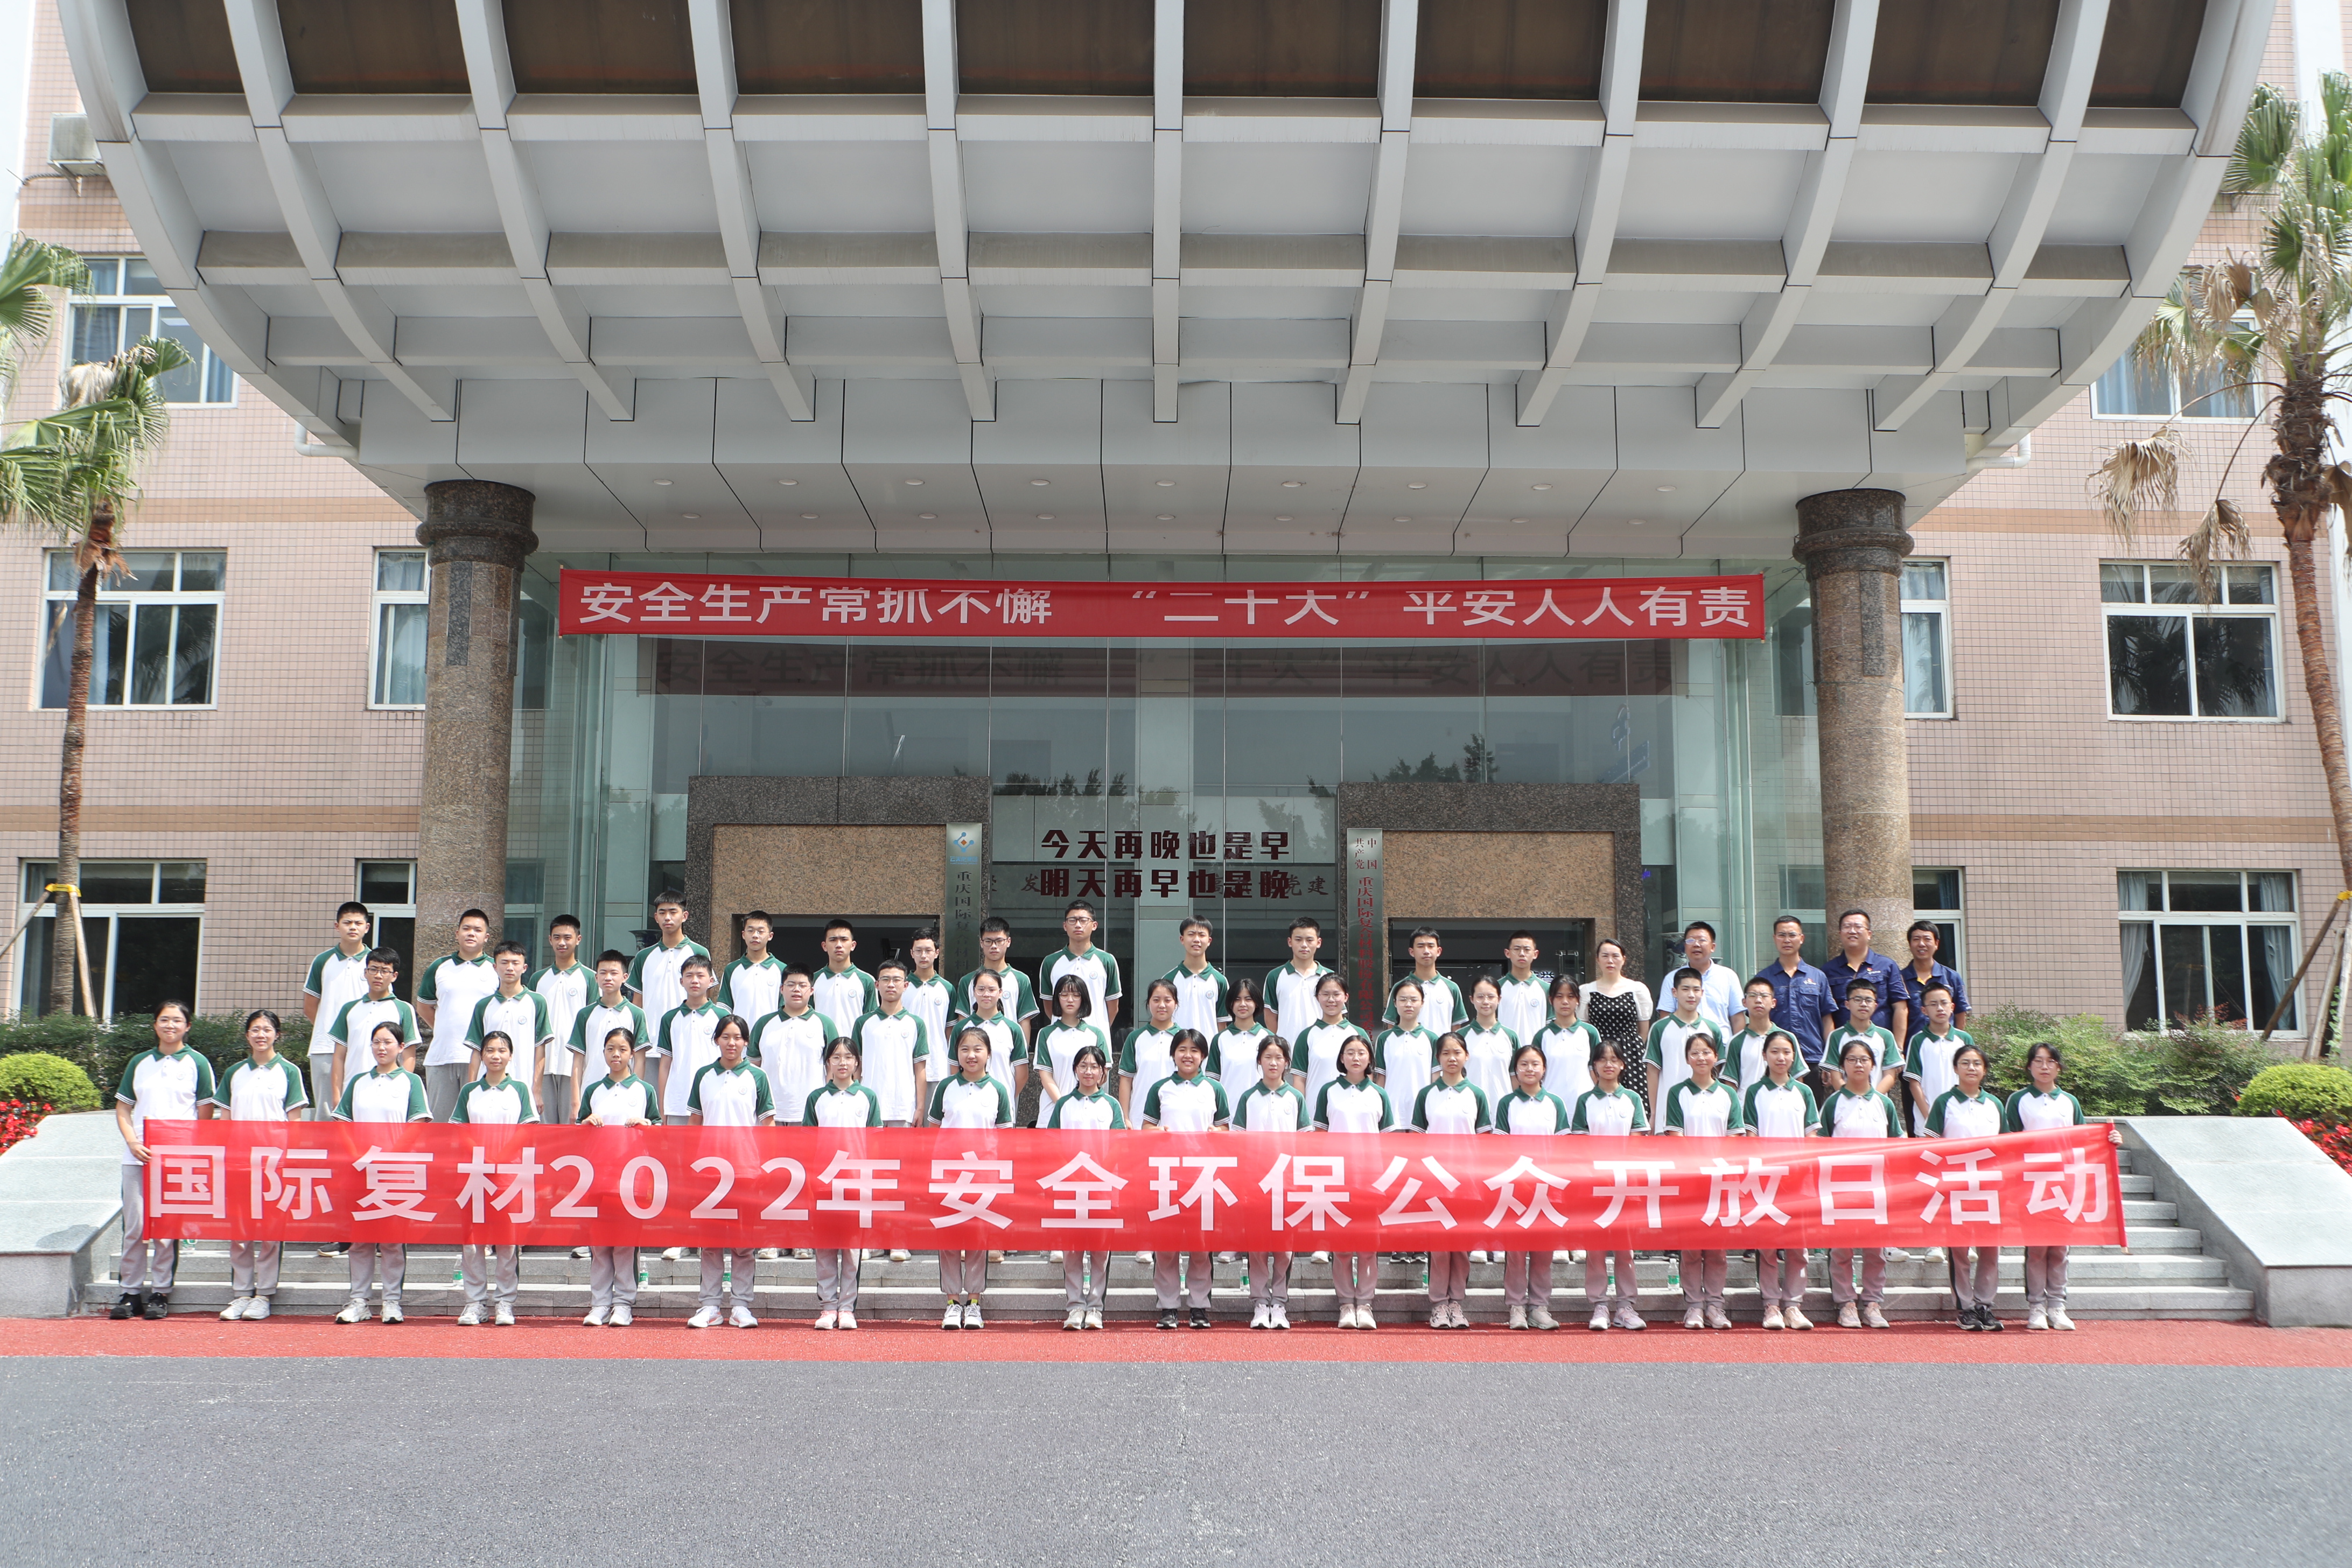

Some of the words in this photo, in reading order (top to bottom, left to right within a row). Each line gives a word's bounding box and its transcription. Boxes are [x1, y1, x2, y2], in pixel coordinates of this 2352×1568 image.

[579, 582, 1053, 625] 安全生产常抓不懈
[1132, 590, 1369, 626] “二十大”
[1403, 586, 1751, 628] 平安人人有责
[1041, 829, 1289, 860] 今天再晚也是早
[1040, 868, 1289, 899] 明天再早也是晚
[1357, 876, 1374, 1041] 重庆国际复合材料股份有限公司委
[150, 1144, 2109, 1232] 国际复材2022年安全环保公众开放日活动
